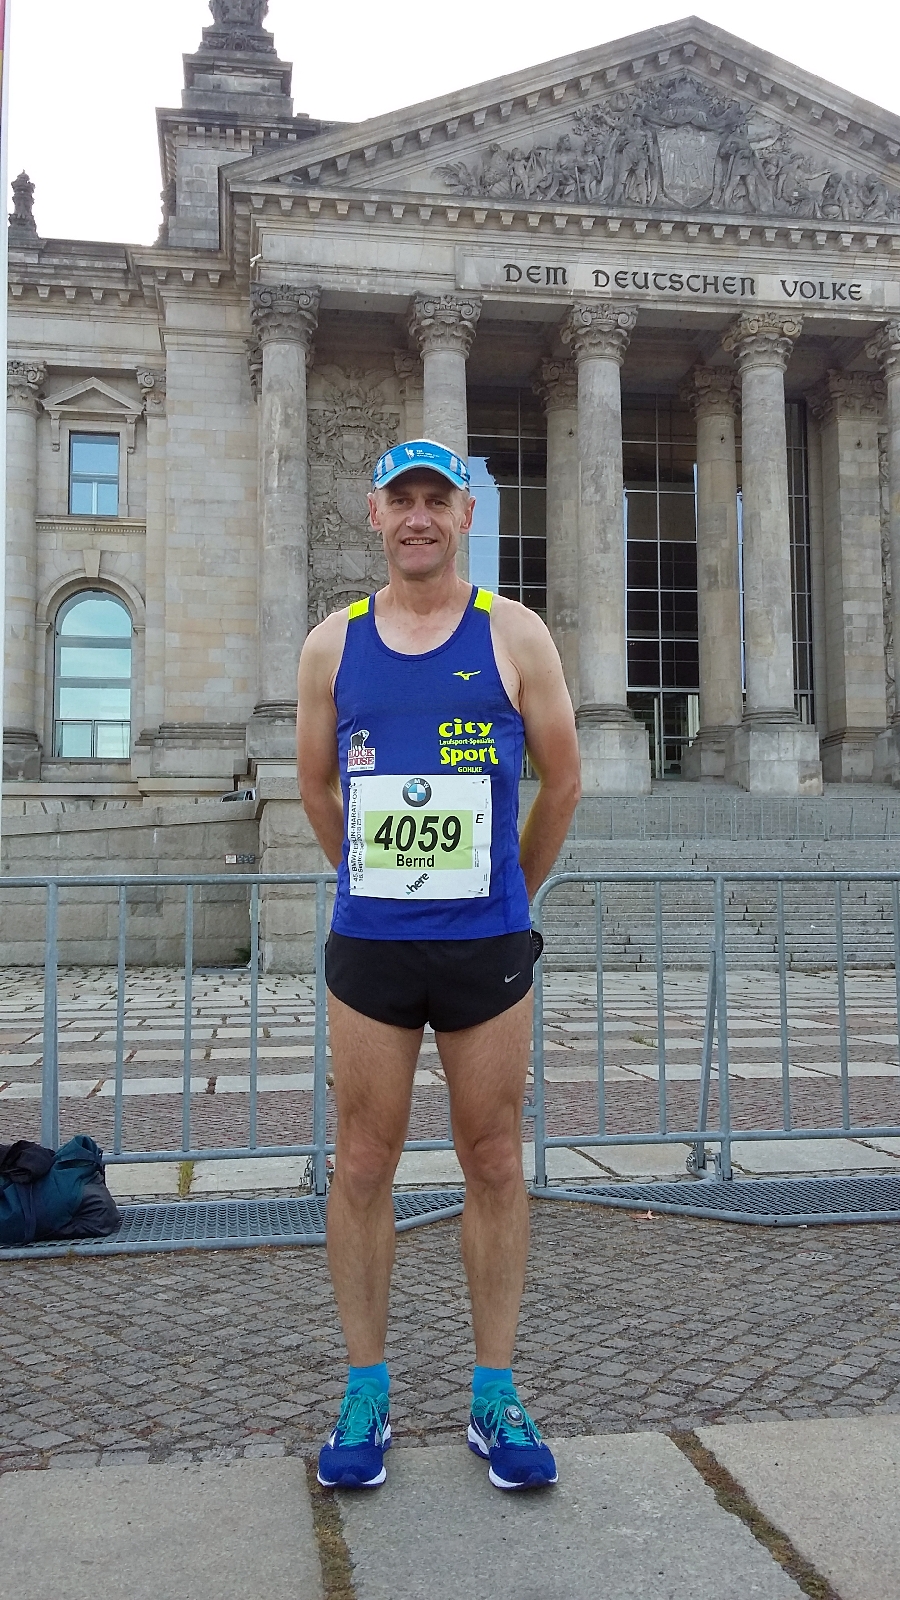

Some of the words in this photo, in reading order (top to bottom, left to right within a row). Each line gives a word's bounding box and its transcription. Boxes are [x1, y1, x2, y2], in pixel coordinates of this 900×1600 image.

[504, 263, 568, 286] DEM
[591, 269, 756, 296] DEUTSCHEN
[779, 279, 862, 301] VOLKE
[440, 745, 499, 766] Sport
[404, 778, 429, 789] BMW
[475, 813, 485, 824] E
[374, 815, 462, 852] 4059
[396, 853, 435, 867] Bernd
[406, 872, 430, 893] here
